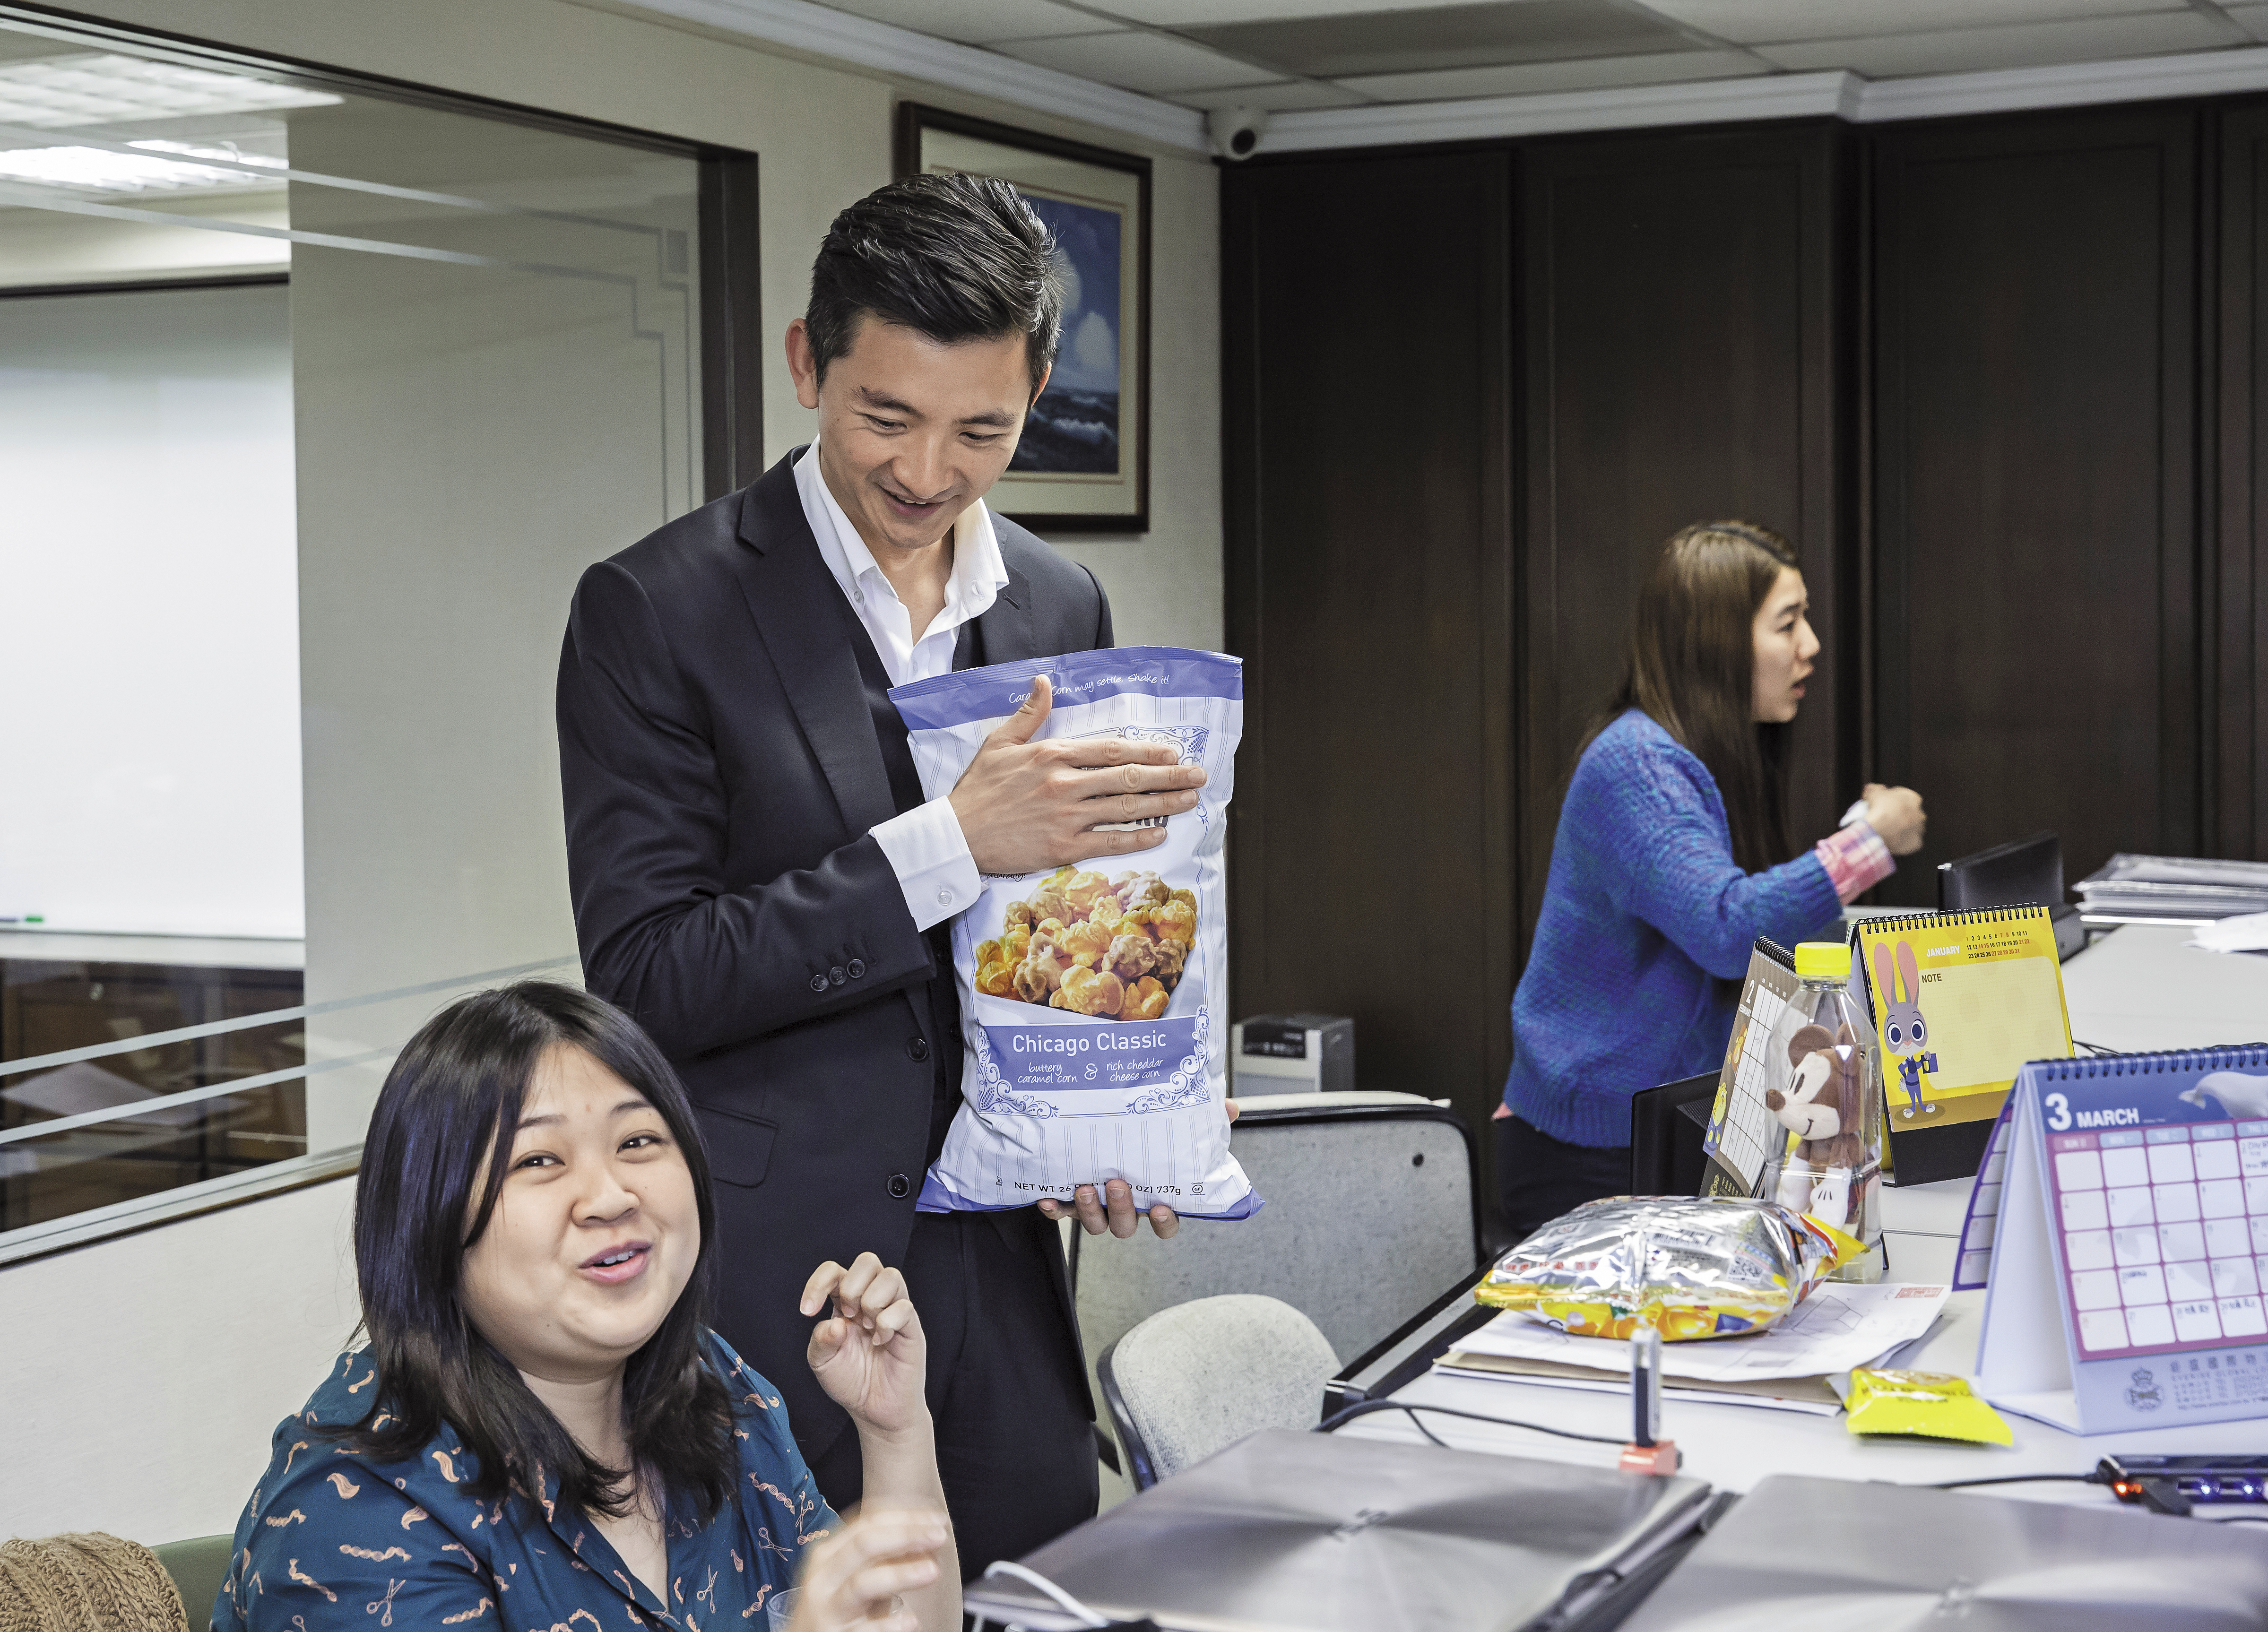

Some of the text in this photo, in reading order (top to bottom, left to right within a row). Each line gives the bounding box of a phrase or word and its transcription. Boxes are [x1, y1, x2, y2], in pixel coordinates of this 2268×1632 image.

[1009, 673, 1169, 703] Cara Corn may settle. Shake it!
[987, 872, 1026, 882] aturally!
[1926, 945, 1959, 957] JANUARY
[1922, 974, 1942, 983] NOTE
[1746, 979, 1755, 1004] 2
[1013, 1030, 1166, 1056] Chicago Classic
[1029, 1062, 1062, 1076] buttery
[1107, 1057, 1163, 1071] rich cheddar
[1018, 1073, 1078, 1083] caramel corn
[1084, 1063, 1098, 1080] &
[1110, 1070, 1160, 1082] cheese corn
[2045, 1093, 2139, 1131] 3 MARCH
[1014, 1182, 1035, 1191] NET
[1157, 1185, 1181, 1195] 737g
